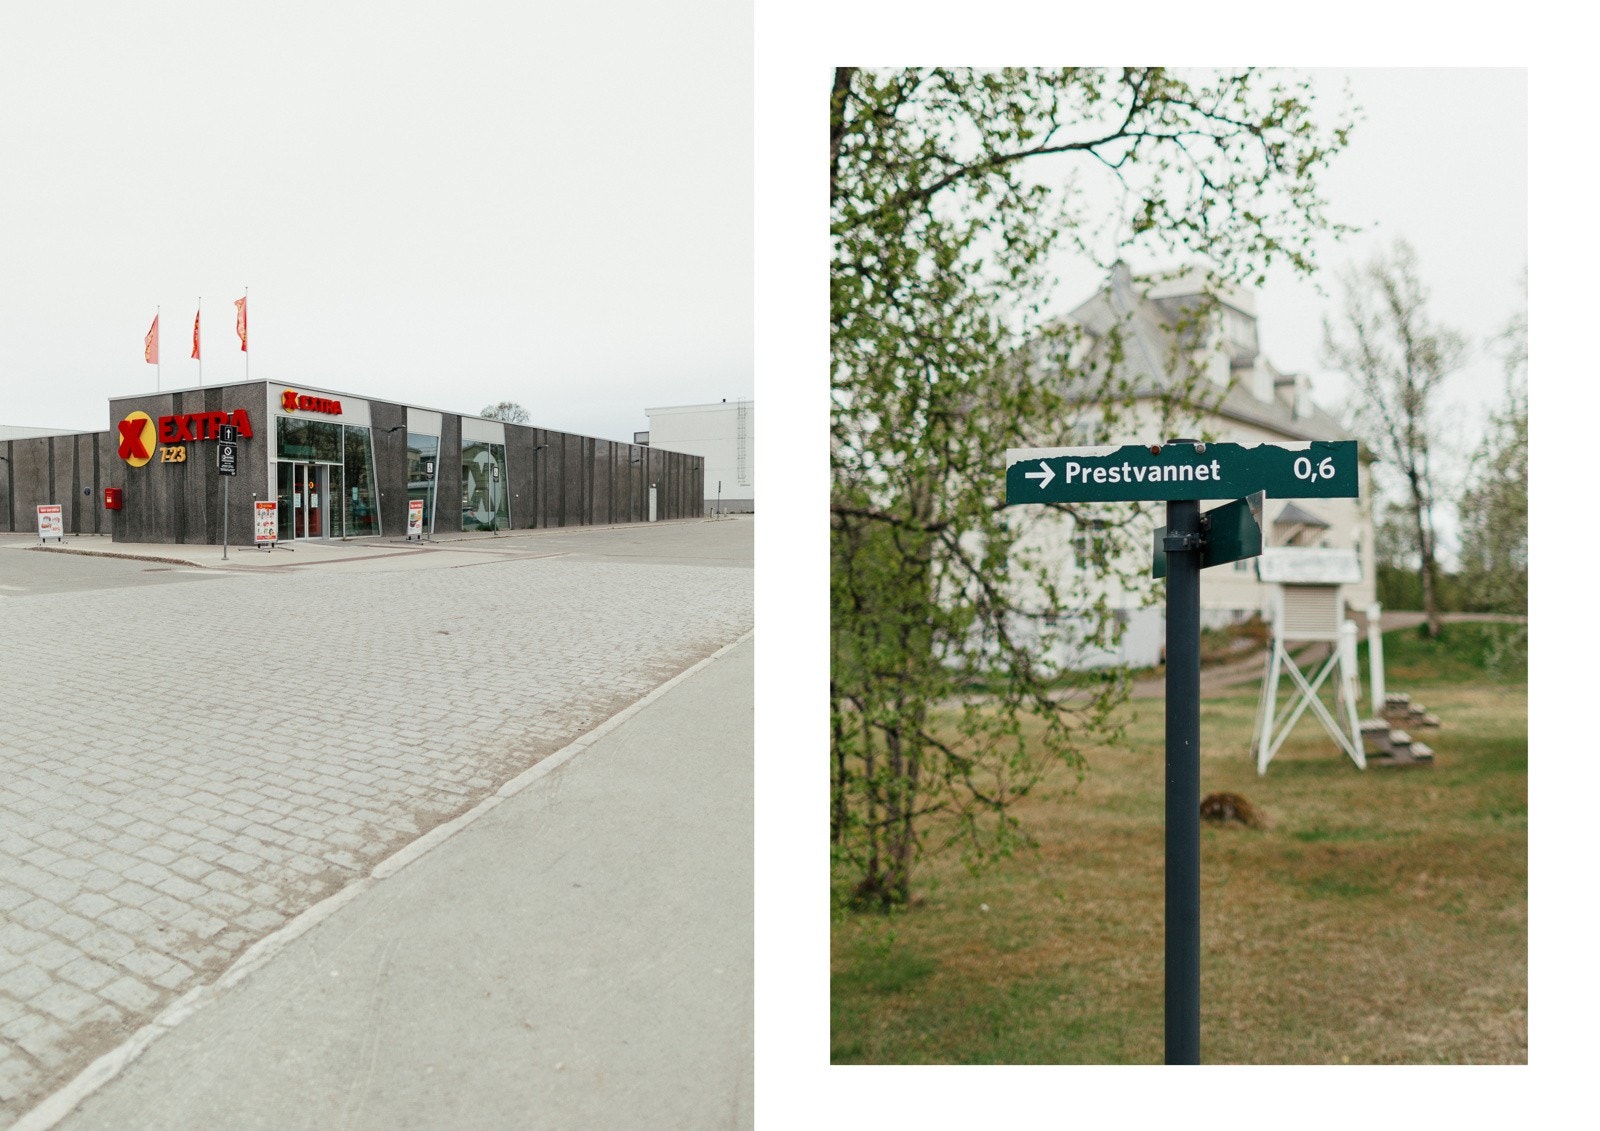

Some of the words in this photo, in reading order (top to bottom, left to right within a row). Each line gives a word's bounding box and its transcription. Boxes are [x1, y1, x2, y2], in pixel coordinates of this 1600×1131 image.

[298, 395, 342, 414] EXTRA
[158, 409, 252, 443] EXTRA
[160, 445, 186, 464] 7-23
[1065, 459, 1221, 484] Prestvannet
[1293, 456, 1336, 483] 0,6
